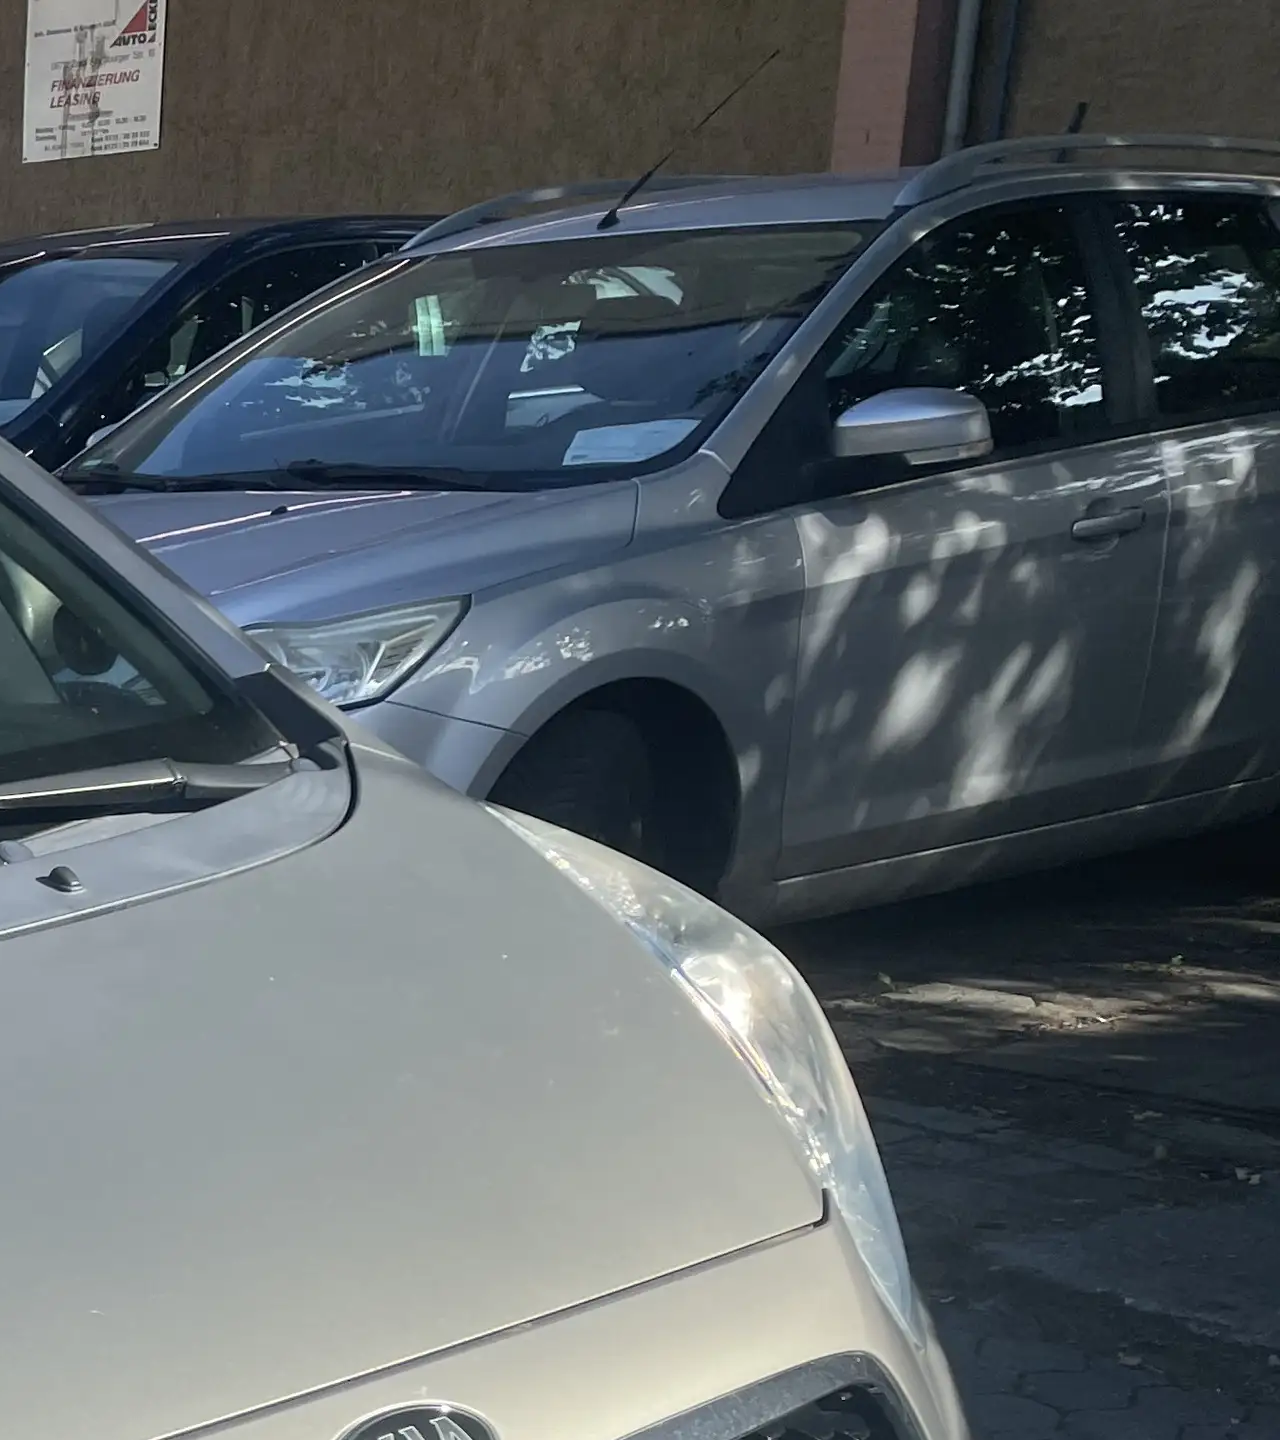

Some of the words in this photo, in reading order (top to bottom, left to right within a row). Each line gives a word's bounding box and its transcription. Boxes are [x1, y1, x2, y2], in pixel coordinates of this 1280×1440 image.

[110, 33, 147, 48] AUTO
[50, 69, 141, 92] FINANZIERUNG
[49, 91, 101, 109] LEASING
